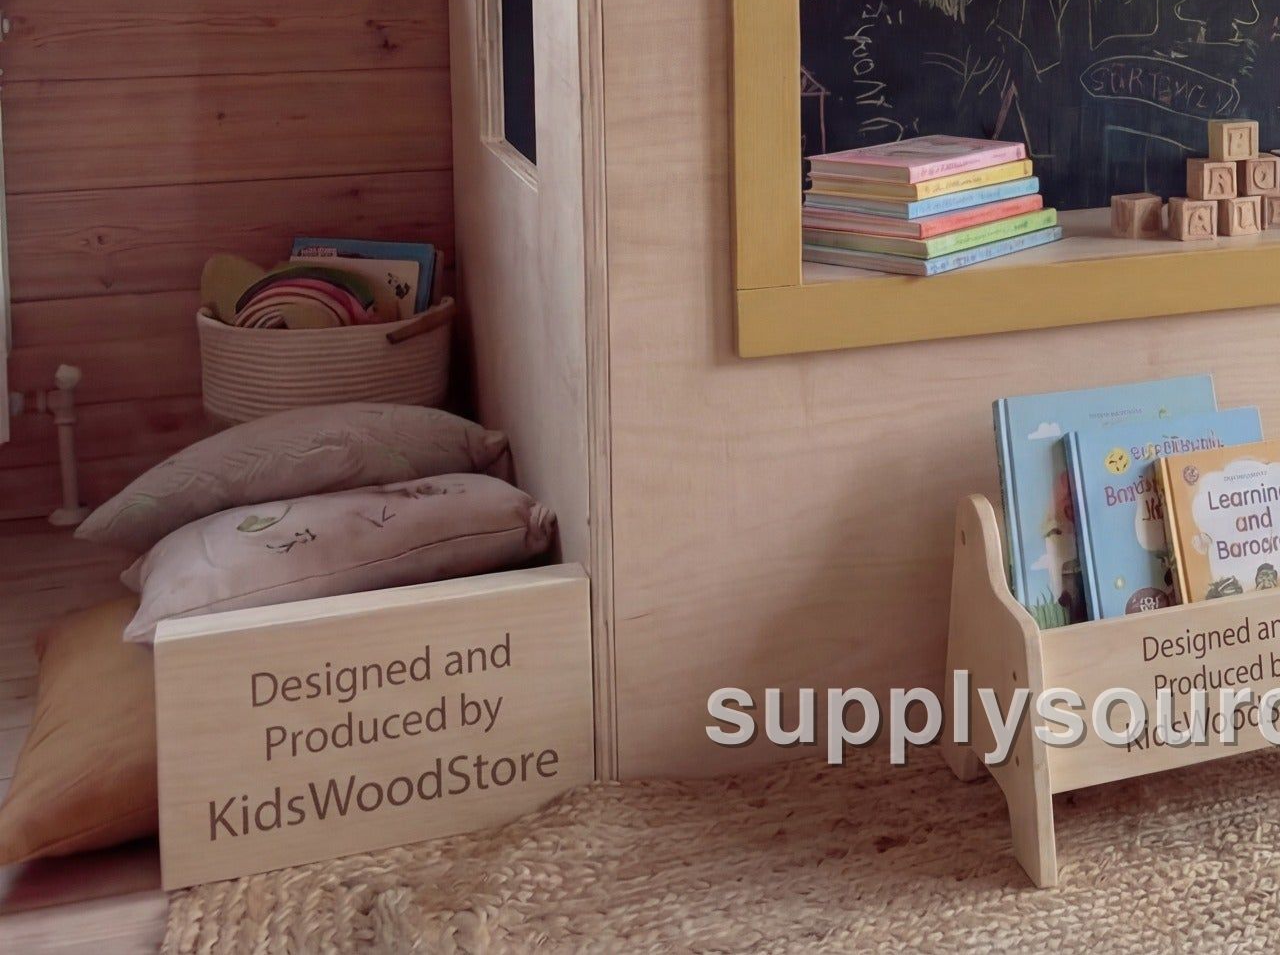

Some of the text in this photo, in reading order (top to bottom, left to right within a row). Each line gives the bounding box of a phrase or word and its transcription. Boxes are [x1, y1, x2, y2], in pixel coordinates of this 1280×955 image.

[1235, 506, 1273, 532] and
[1141, 617, 1250, 661] Designed
[250, 633, 512, 708] Designed and
[1153, 655, 1263, 701] Produced
[264, 693, 503, 761] Produced by
[208, 748, 560, 841] KidsWoodStore
